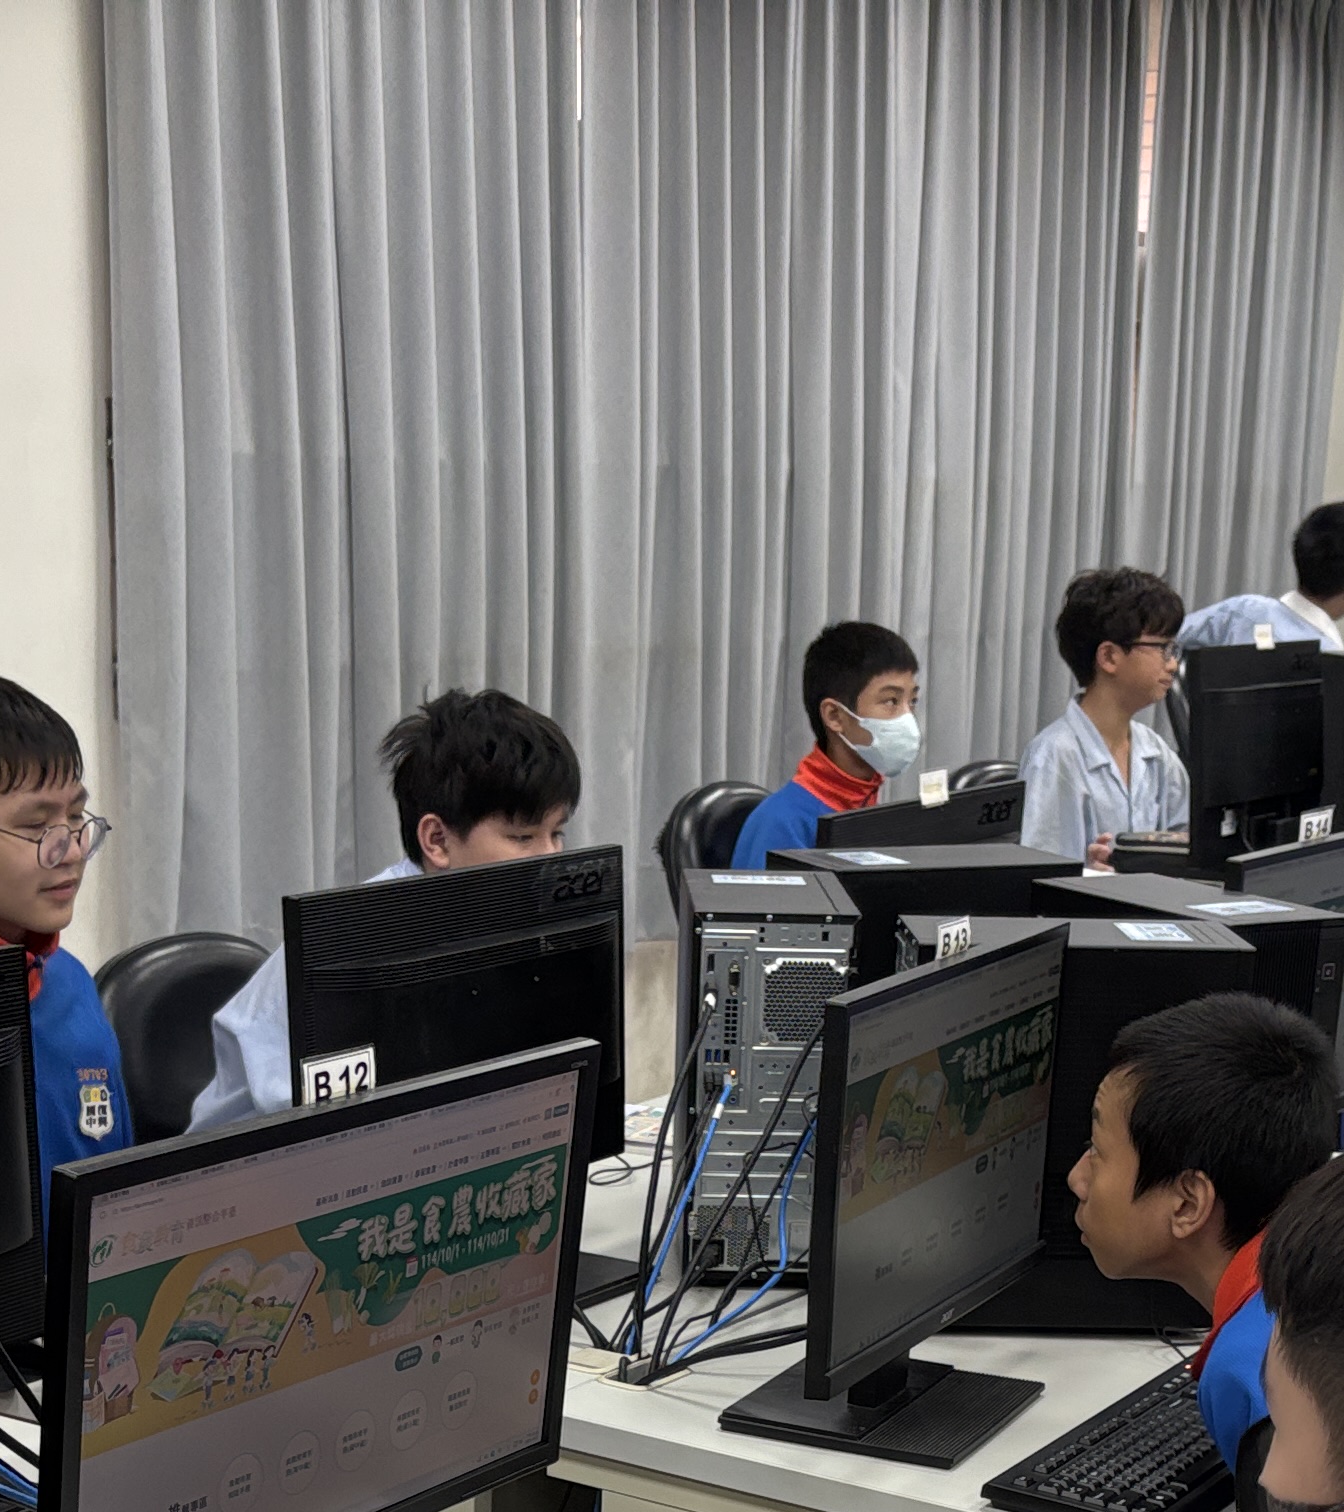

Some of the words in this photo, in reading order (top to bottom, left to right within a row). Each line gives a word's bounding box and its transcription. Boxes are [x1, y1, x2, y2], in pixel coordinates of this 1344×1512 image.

[1315, 817, 1329, 835] 14
[942, 932, 951, 956] B
[954, 928, 968, 952] 13
[314, 1071, 332, 1101] B
[339, 1062, 368, 1099] 12
[358, 1159, 558, 1260] 我是食農收藏家
